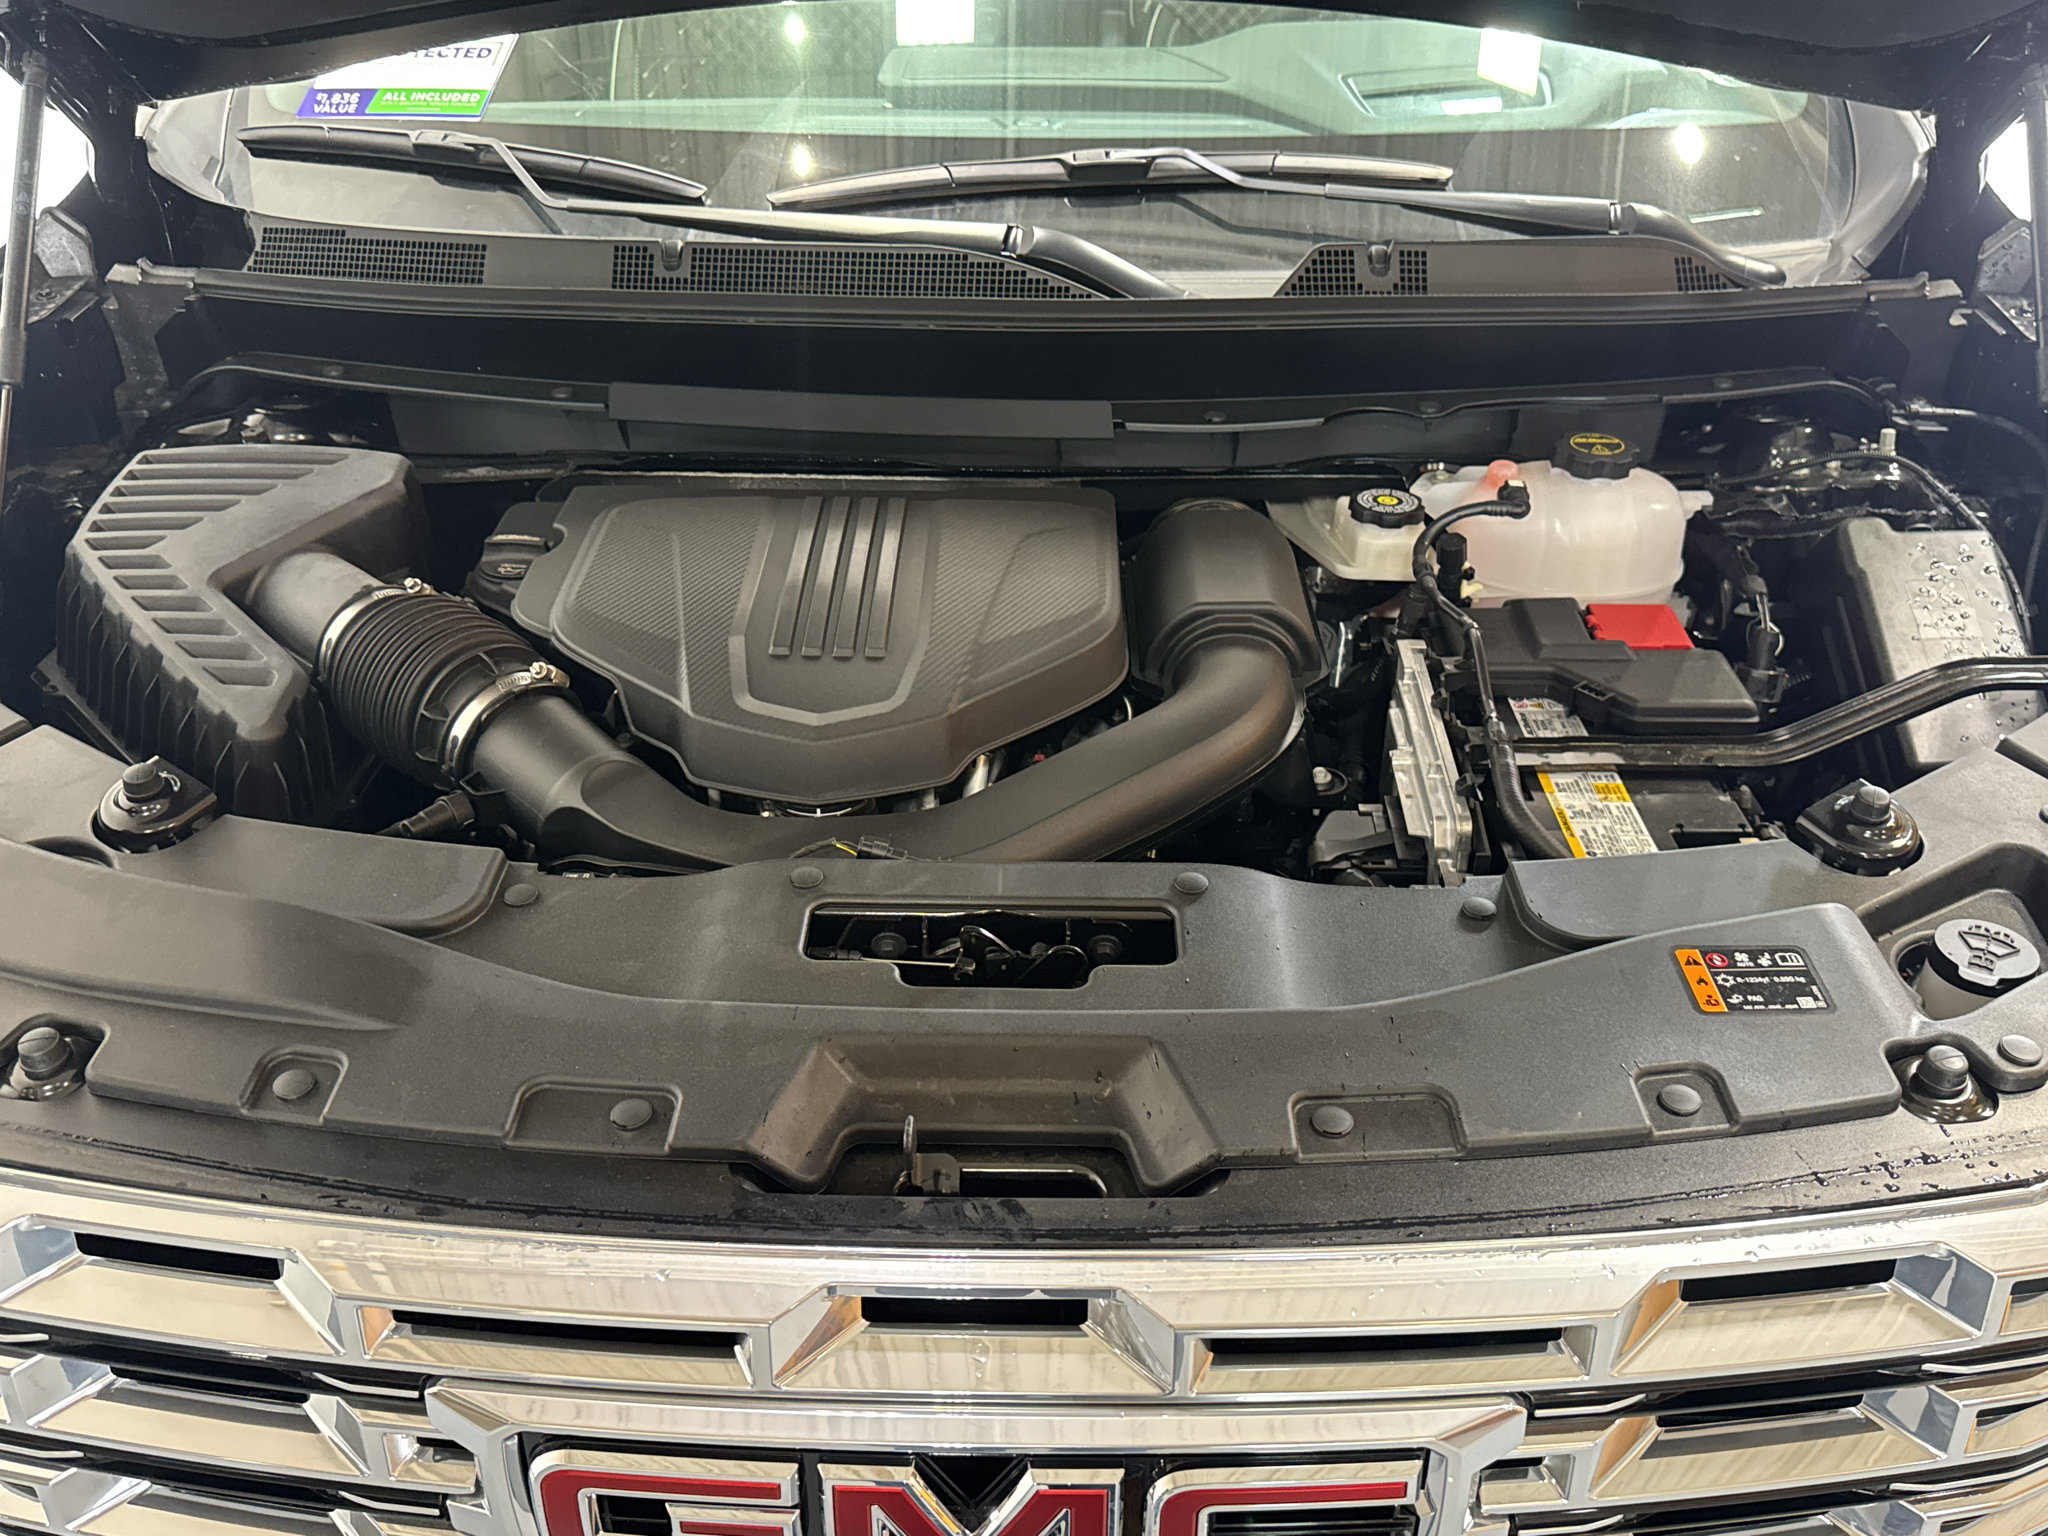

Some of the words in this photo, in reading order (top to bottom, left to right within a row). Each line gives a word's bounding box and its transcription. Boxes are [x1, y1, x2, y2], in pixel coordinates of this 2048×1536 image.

[382, 92, 407, 102] ALL
[410, 92, 481, 103] INCLUDED
[313, 103, 358, 113] VALUE
